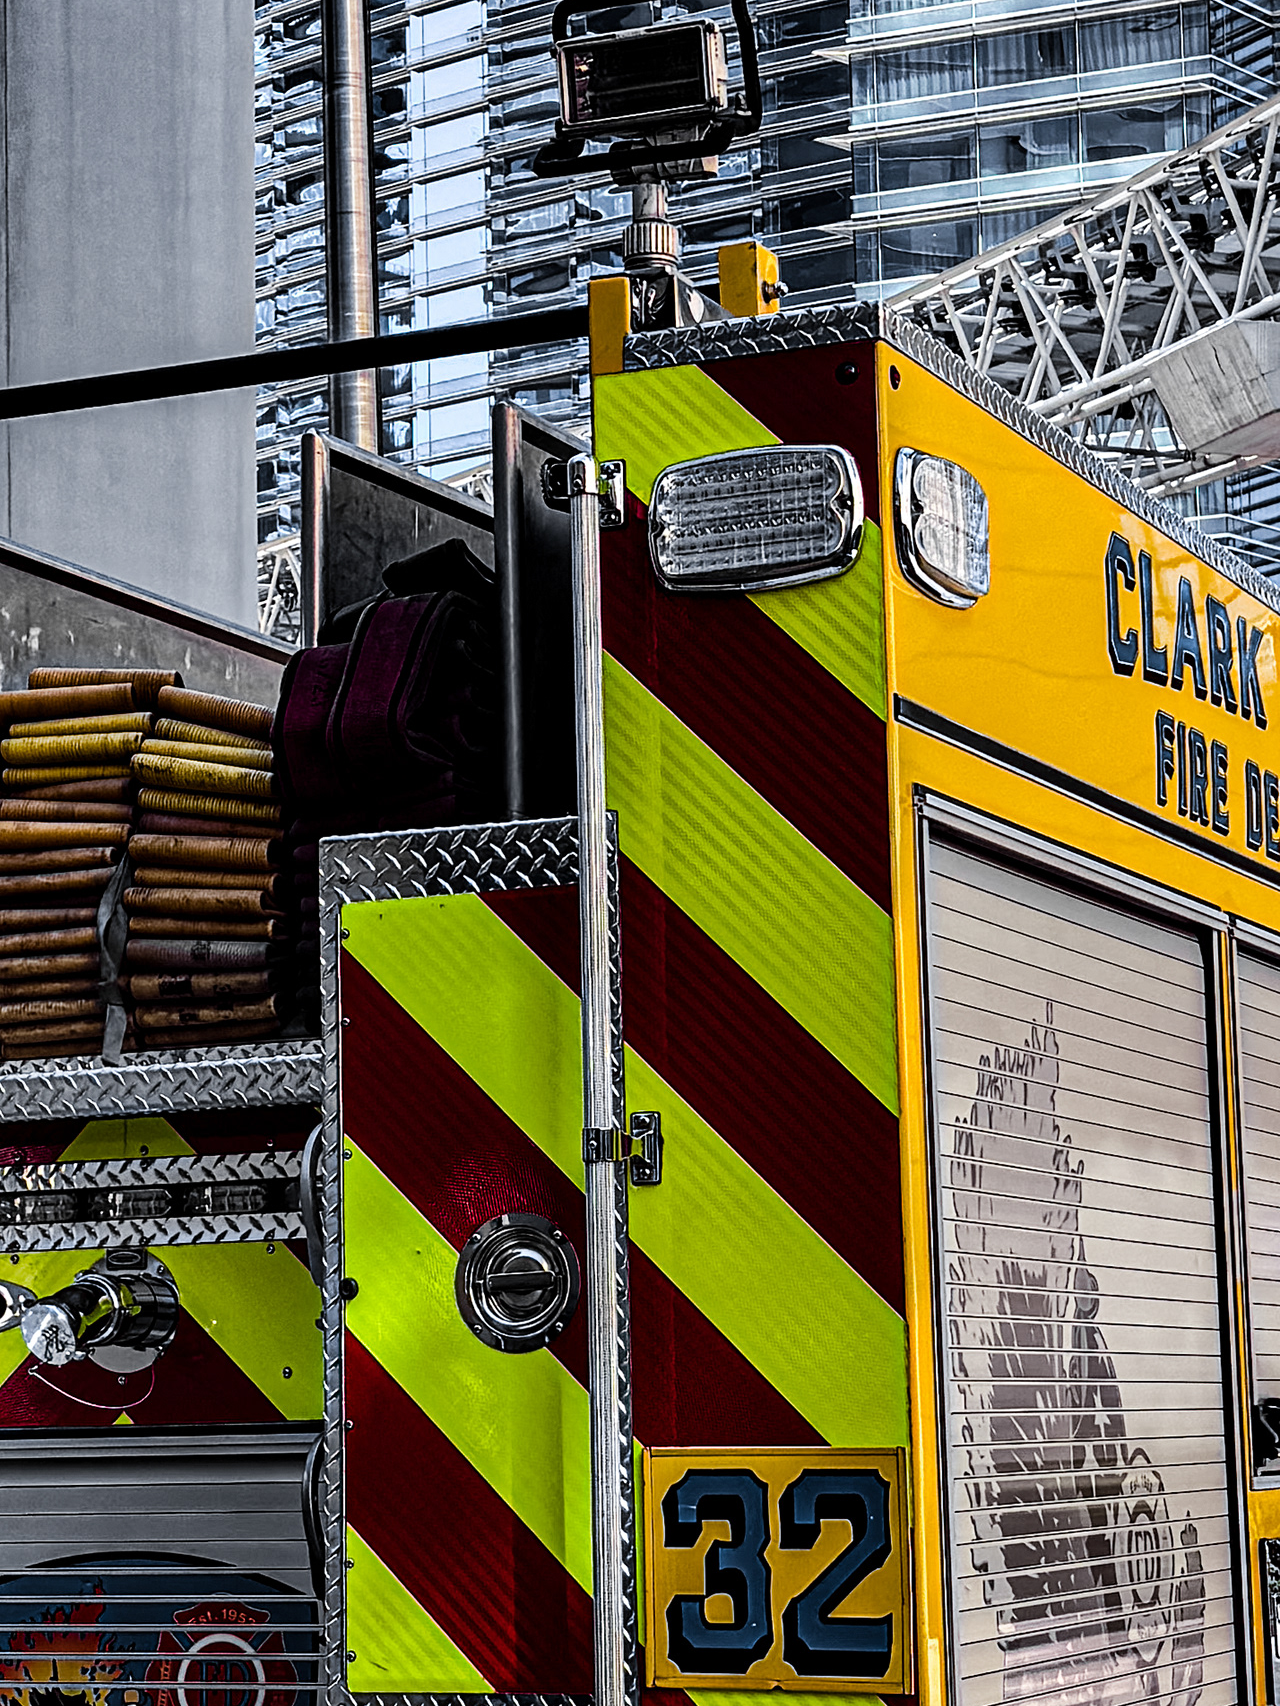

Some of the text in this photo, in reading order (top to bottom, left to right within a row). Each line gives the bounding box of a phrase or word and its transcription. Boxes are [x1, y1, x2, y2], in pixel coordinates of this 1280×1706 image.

[1104, 530, 1268, 730] CLARK
[1155, 709, 1230, 837] FIRE
[660, 1467, 895, 1679] 32
